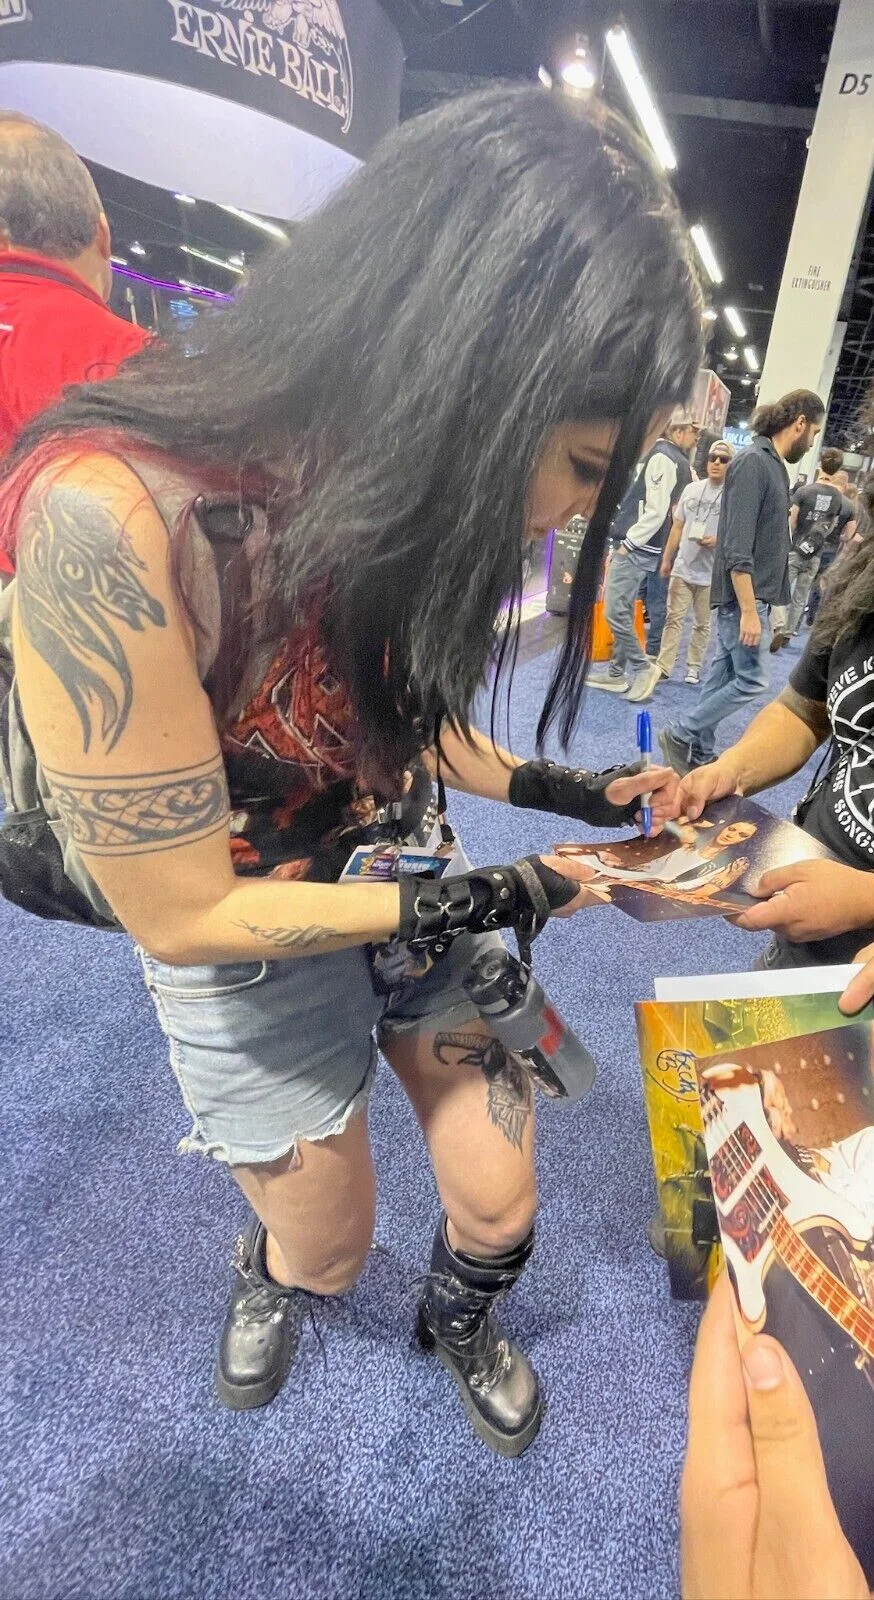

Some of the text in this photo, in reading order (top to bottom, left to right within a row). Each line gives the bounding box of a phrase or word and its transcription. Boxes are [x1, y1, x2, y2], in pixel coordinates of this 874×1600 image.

[167, 0, 346, 118] ERNIE BALL
[838, 73, 873, 96] D5
[808, 265, 821, 278] FIRE
[791, 277, 831, 291] EXTINGUISHER
